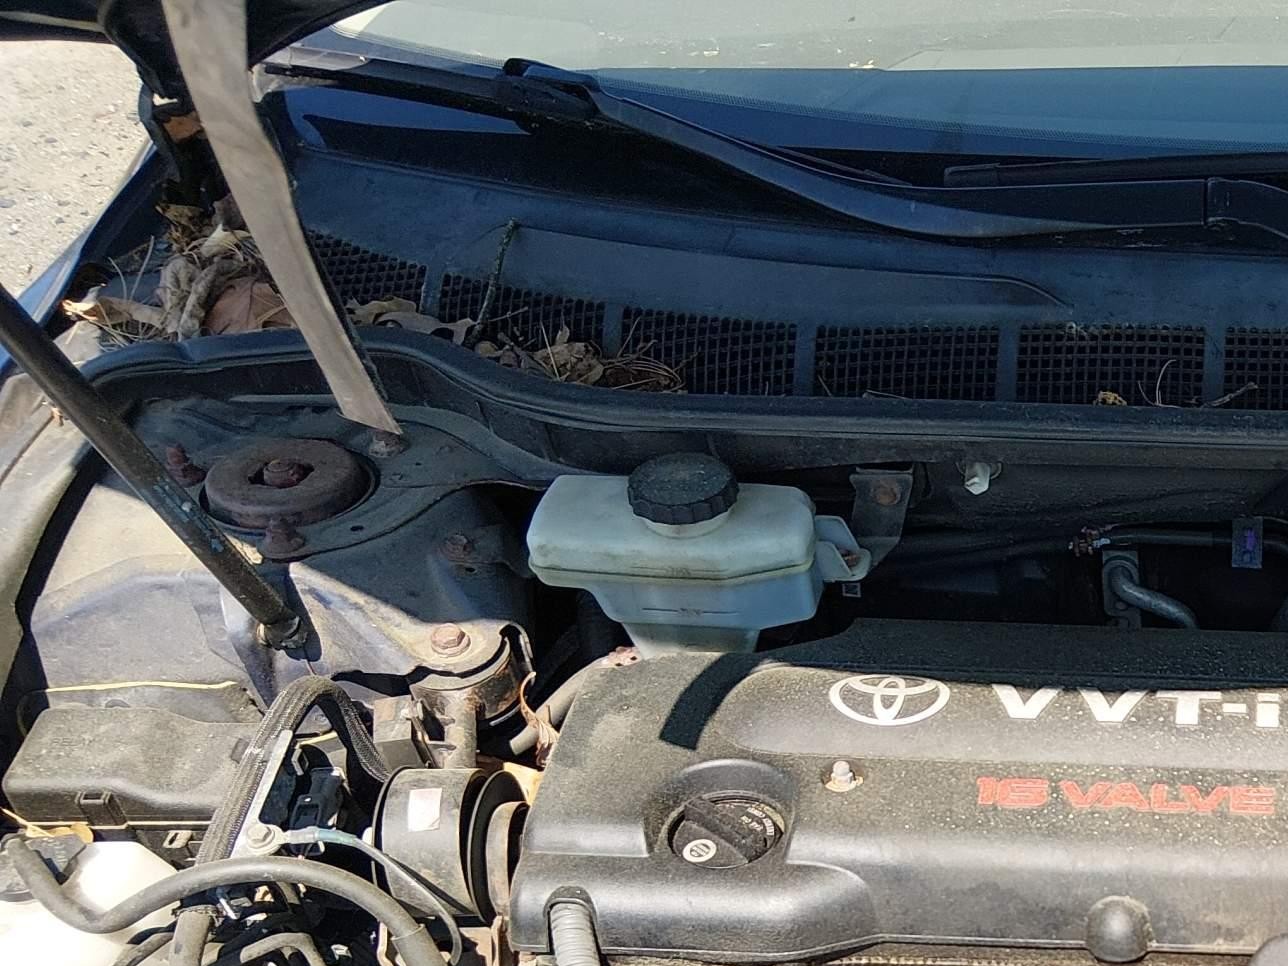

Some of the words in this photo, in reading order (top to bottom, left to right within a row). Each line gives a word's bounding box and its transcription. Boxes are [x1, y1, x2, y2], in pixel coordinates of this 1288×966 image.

[991, 683, 1280, 728] VVT-i
[976, 775, 1050, 809] 16
[1058, 778, 1276, 815] VALVE
